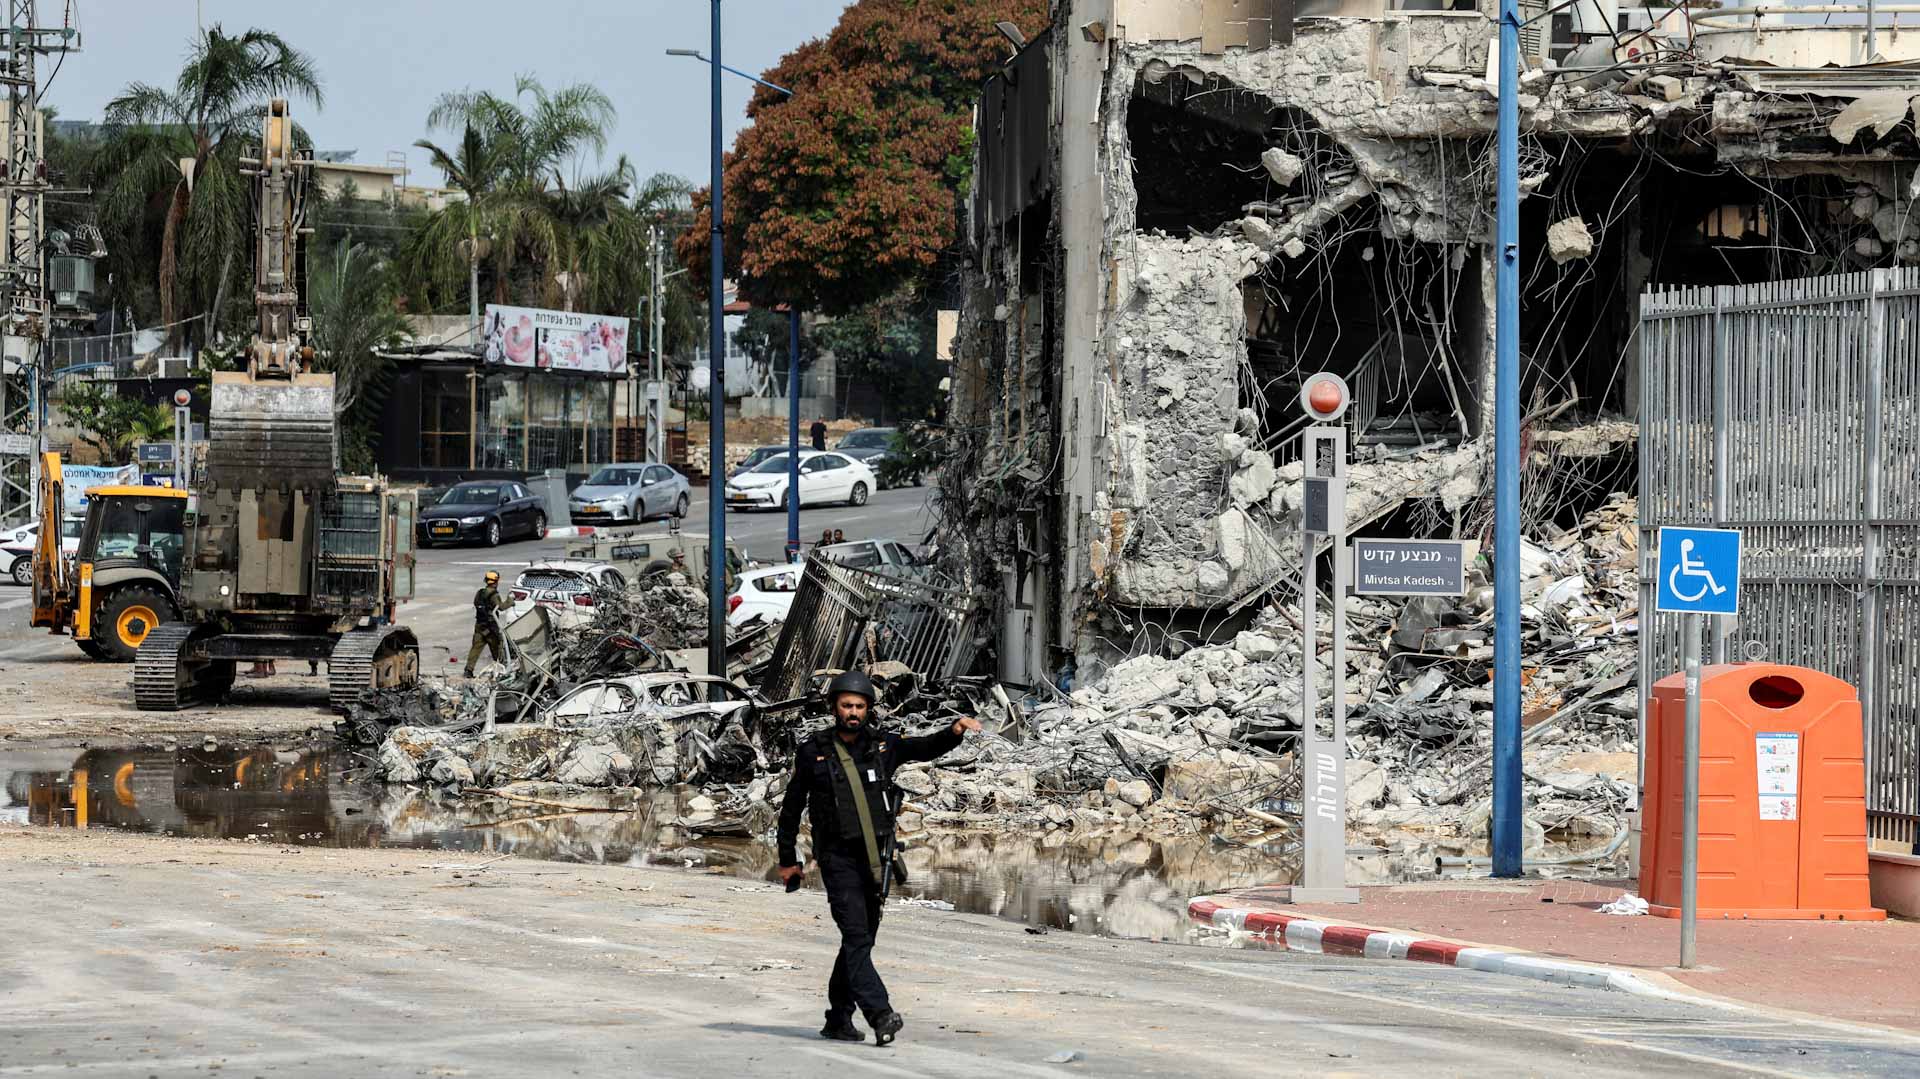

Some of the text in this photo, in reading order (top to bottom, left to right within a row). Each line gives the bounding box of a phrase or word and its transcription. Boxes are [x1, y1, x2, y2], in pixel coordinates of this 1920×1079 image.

[1363, 549, 1396, 564] קדש
[1400, 550, 1441, 563] מבצע
[1364, 574, 1400, 585] Mivtsa
[1403, 575, 1445, 586] Kadesh
